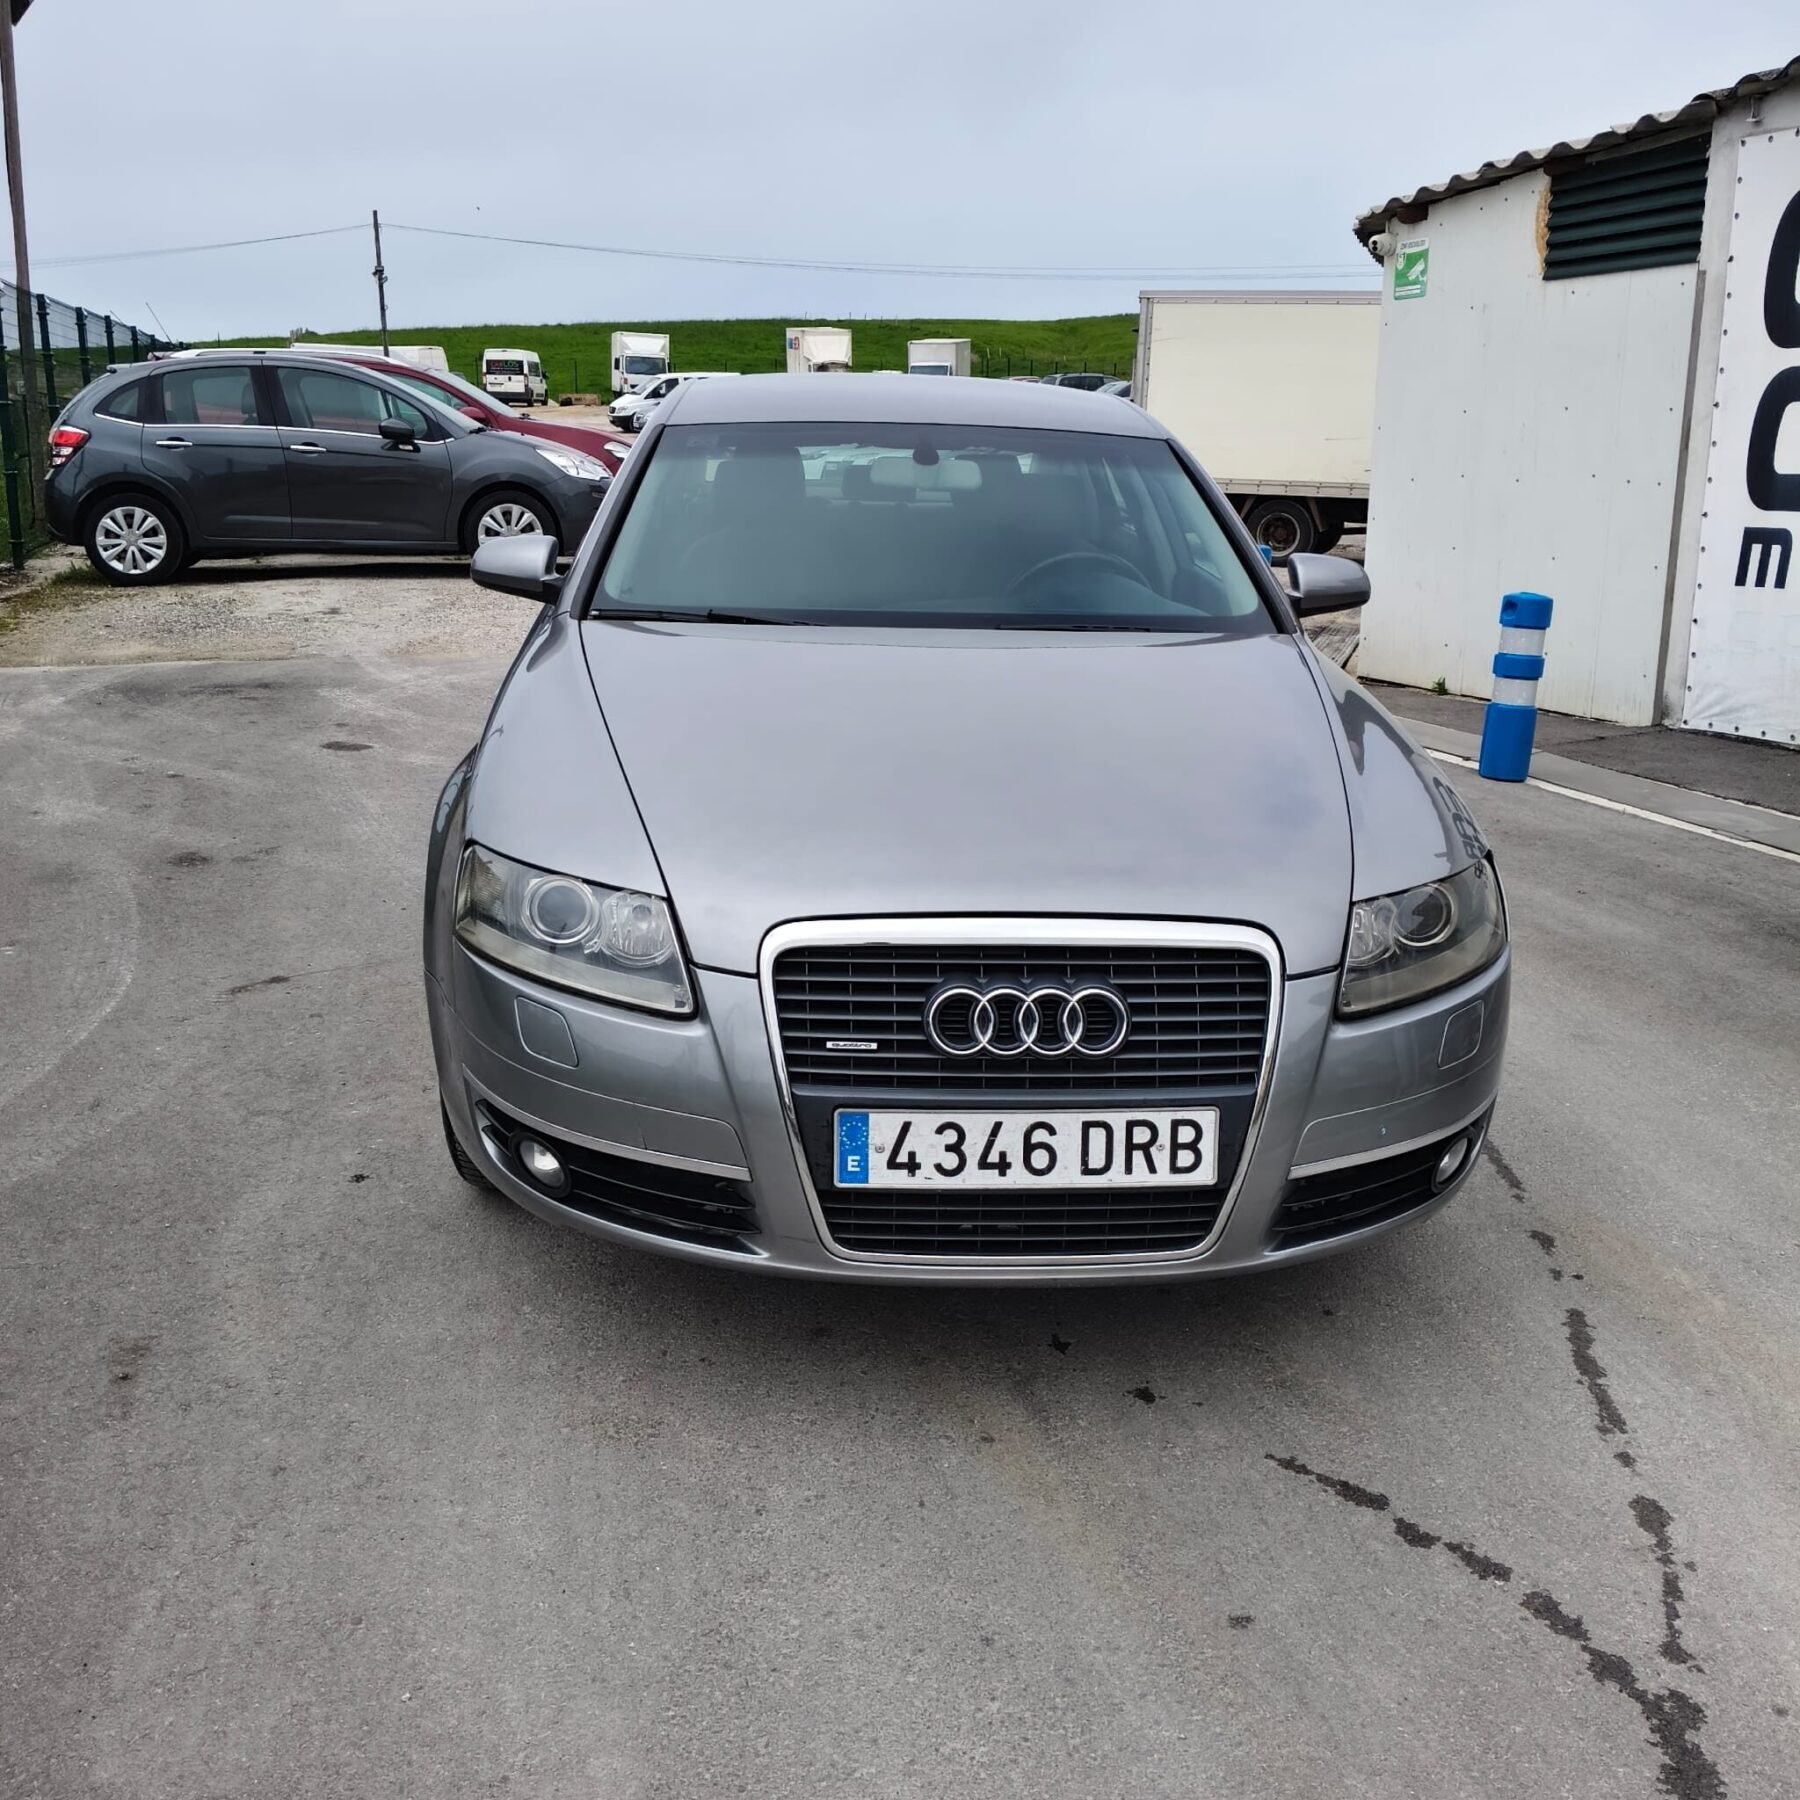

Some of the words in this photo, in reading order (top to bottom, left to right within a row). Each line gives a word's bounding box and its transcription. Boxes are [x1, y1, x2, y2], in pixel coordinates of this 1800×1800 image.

[847, 1155, 861, 1172] E
[886, 1120, 1058, 1177] 4346
[1080, 1118, 1204, 1176] DRB
